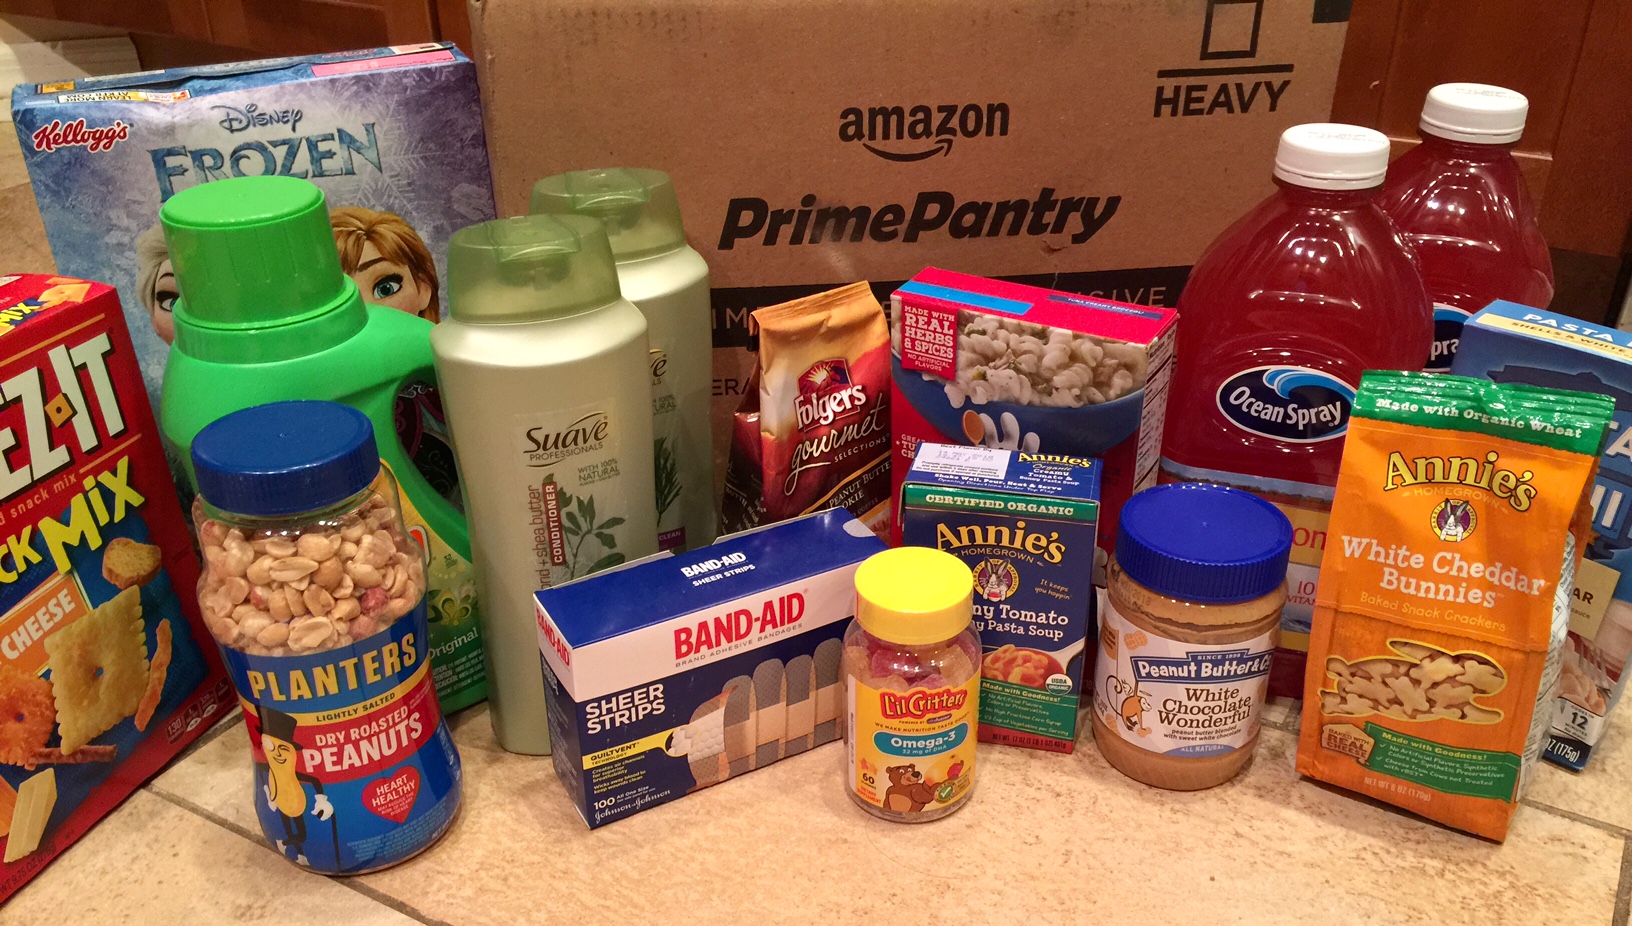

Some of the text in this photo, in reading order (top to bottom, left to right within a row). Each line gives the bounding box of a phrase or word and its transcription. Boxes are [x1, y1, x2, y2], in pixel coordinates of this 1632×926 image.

[1153, 79, 1291, 118] HEAVY
[838, 102, 1010, 142] amazon
[33, 119, 129, 152] Kellogg's
[147, 122, 384, 203] FROZEN
[904, 306, 955, 321] MADE WITH
[905, 313, 953, 335] REAL
[905, 326, 953, 347] HERBS
[1511, 322, 1561, 336] SHELLS
[1581, 338, 1626, 352] WHITE
[1523, 313, 1615, 342] PASTA
[904, 338, 953, 358] & SPICES
[915, 360, 942, 372] FLAVORS
[918, 356, 950, 368] ARTIFICIAL
[794, 384, 866, 430] Folgers
[1229, 386, 1342, 430] Ocean Spray
[1375, 398, 1583, 439] Made with Organic Wheat
[523, 418, 609, 454] Suave
[784, 393, 887, 496] gourmet
[529, 442, 604, 462] PROFESSIONALS
[834, 437, 887, 463] SELECTIONS
[1018, 453, 1092, 468] Annie's
[578, 464, 598, 473] WITH
[579, 465, 621, 482] NATURAL
[1028, 472, 1063, 480] Tomato
[1384, 451, 1538, 512] Annie's
[10, 473, 77, 519] snack mix
[828, 480, 861, 508] PEANUT
[925, 493, 1074, 516] CERTIFIED ORGANIC
[1413, 486, 1501, 508] HOMEGROWN
[529, 485, 548, 558] shea butter
[545, 484, 563, 563] CONDITIONER
[658, 530, 681, 541] CLEAN
[935, 521, 1066, 565] Annie's
[680, 552, 747, 578] BAND-AID
[961, 547, 1034, 563] HOMEGROWN
[1341, 536, 1546, 597] White Cheddar
[692, 564, 756, 587] SHEER STRIPS
[1040, 578, 1069, 593] It keeps
[1034, 587, 1047, 595] you
[1379, 567, 1496, 609] Bunnies
[999, 604, 1069, 626] Tomato
[1360, 591, 1506, 632] Baked Snack Crackers
[1, 588, 76, 660] CHEESE
[674, 592, 806, 661] BAND-AID
[987, 619, 1025, 636] Pasta
[1028, 626, 1064, 642] Soup
[536, 607, 571, 667] BAND-AID
[675, 623, 803, 668] BRAND ADHESIVE BANDAGES
[247, 632, 417, 702] PLANTERS
[1138, 661, 1197, 677] Peanut
[1201, 661, 1253, 678] Butter
[586, 683, 664, 720] SHEER
[908, 692, 964, 716] Critters
[982, 682, 1060, 703] Made with Goodness!
[1185, 687, 1240, 702] White
[316, 706, 359, 723] LIGHTLY
[362, 692, 396, 712] SALTED
[587, 699, 666, 735] STRIPS
[1158, 705, 1251, 729] Wonderful
[1162, 696, 1251, 716] Chocolate
[167, 718, 182, 735] 130
[315, 705, 409, 747] DRY ROASTED
[1215, 725, 1237, 734] blended
[1571, 712, 1589, 730] 12
[302, 711, 423, 773] PEANUTS
[890, 730, 956, 749] Omega-3
[1216, 729, 1241, 740] chocolate
[1327, 733, 1367, 752] REAL
[1328, 728, 1369, 745] BAKED WITH
[1382, 732, 1487, 760] Made with Goodness!
[591, 742, 637, 761] QUILTVENT
[592, 752, 627, 765] TECHNOLOGY
[1326, 741, 1367, 758] CHEESE
[1554, 741, 1580, 763] (175g)
[1385, 758, 1410, 768] Cheese
[1411, 765, 1428, 774] from
[1430, 771, 1448, 780] Cows
[1465, 778, 1494, 786] Treated
[1388, 751, 1409, 760] Colors
[1420, 760, 1455, 773] Synthetic
[1456, 768, 1505, 778] Preservatives
[376, 774, 408, 796] HEART
[862, 772, 875, 784] 60
[372, 780, 416, 807] HEALTHY
[593, 797, 615, 811] 100
[594, 790, 671, 824] Johnson Johnson
